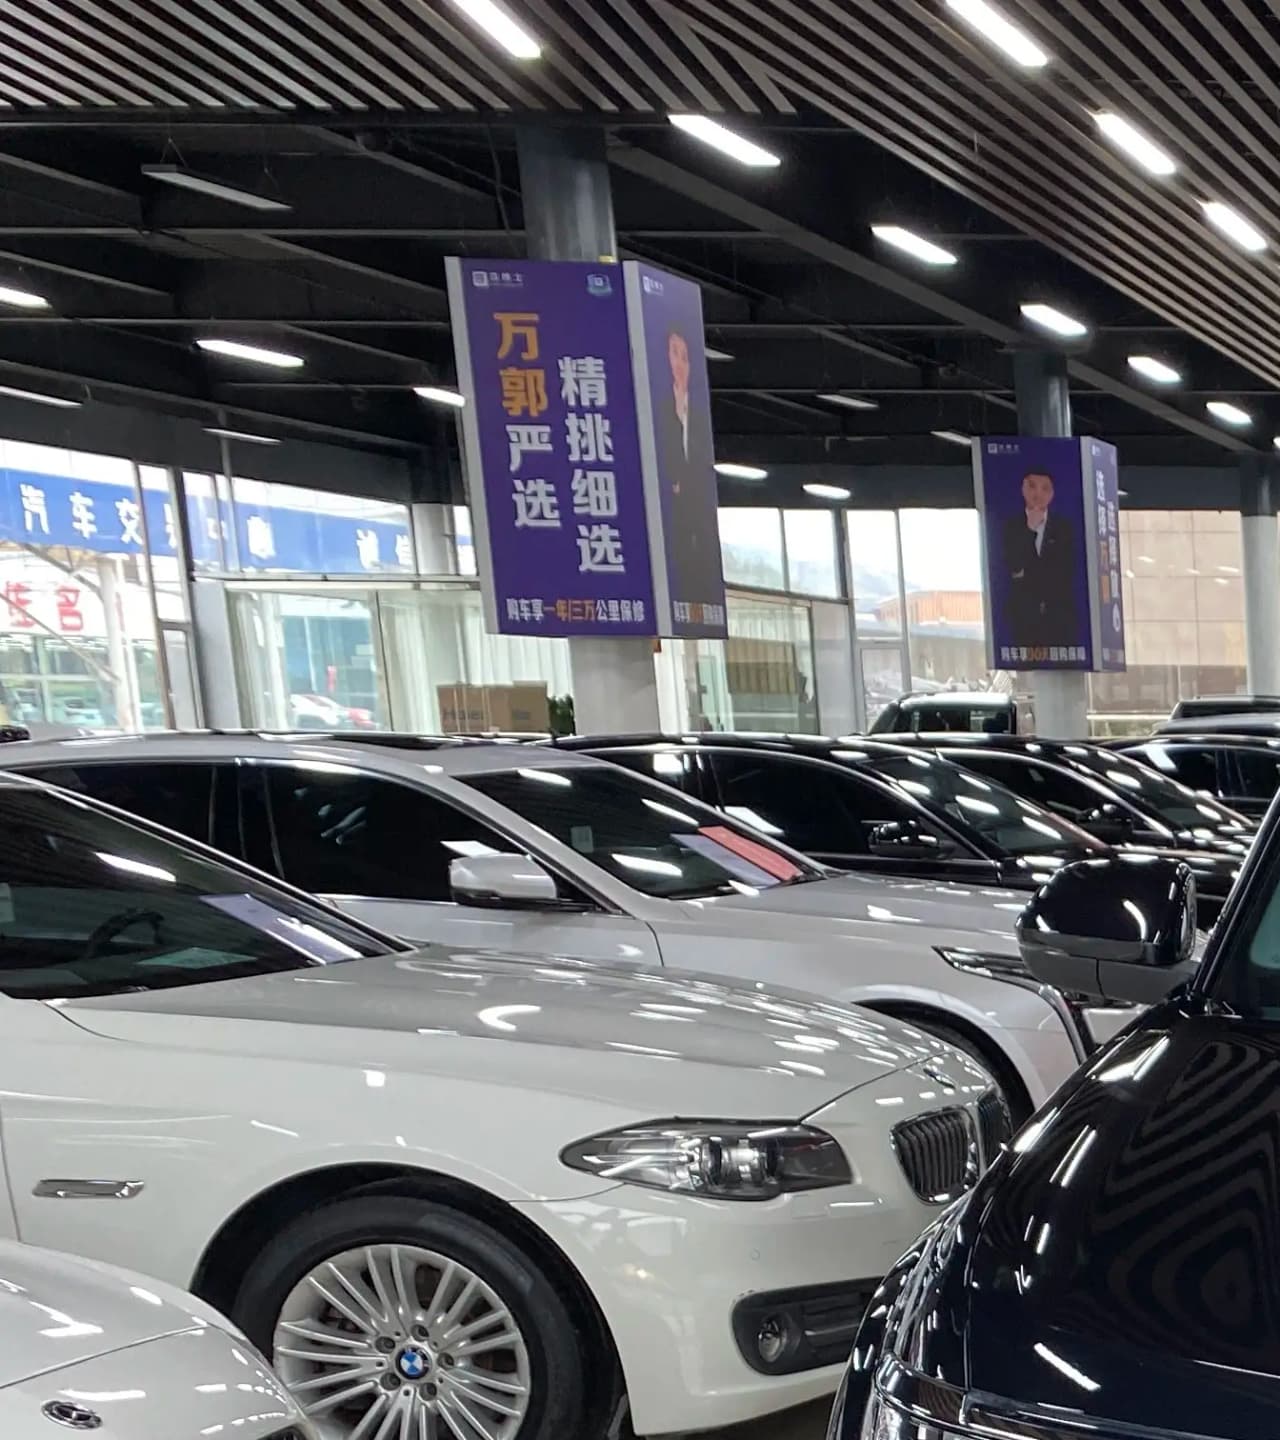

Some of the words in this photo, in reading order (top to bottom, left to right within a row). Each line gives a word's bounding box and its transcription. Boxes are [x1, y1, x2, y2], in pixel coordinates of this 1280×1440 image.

[493, 312, 562, 528] 万郭严选
[557, 355, 626, 574] 精挑细选
